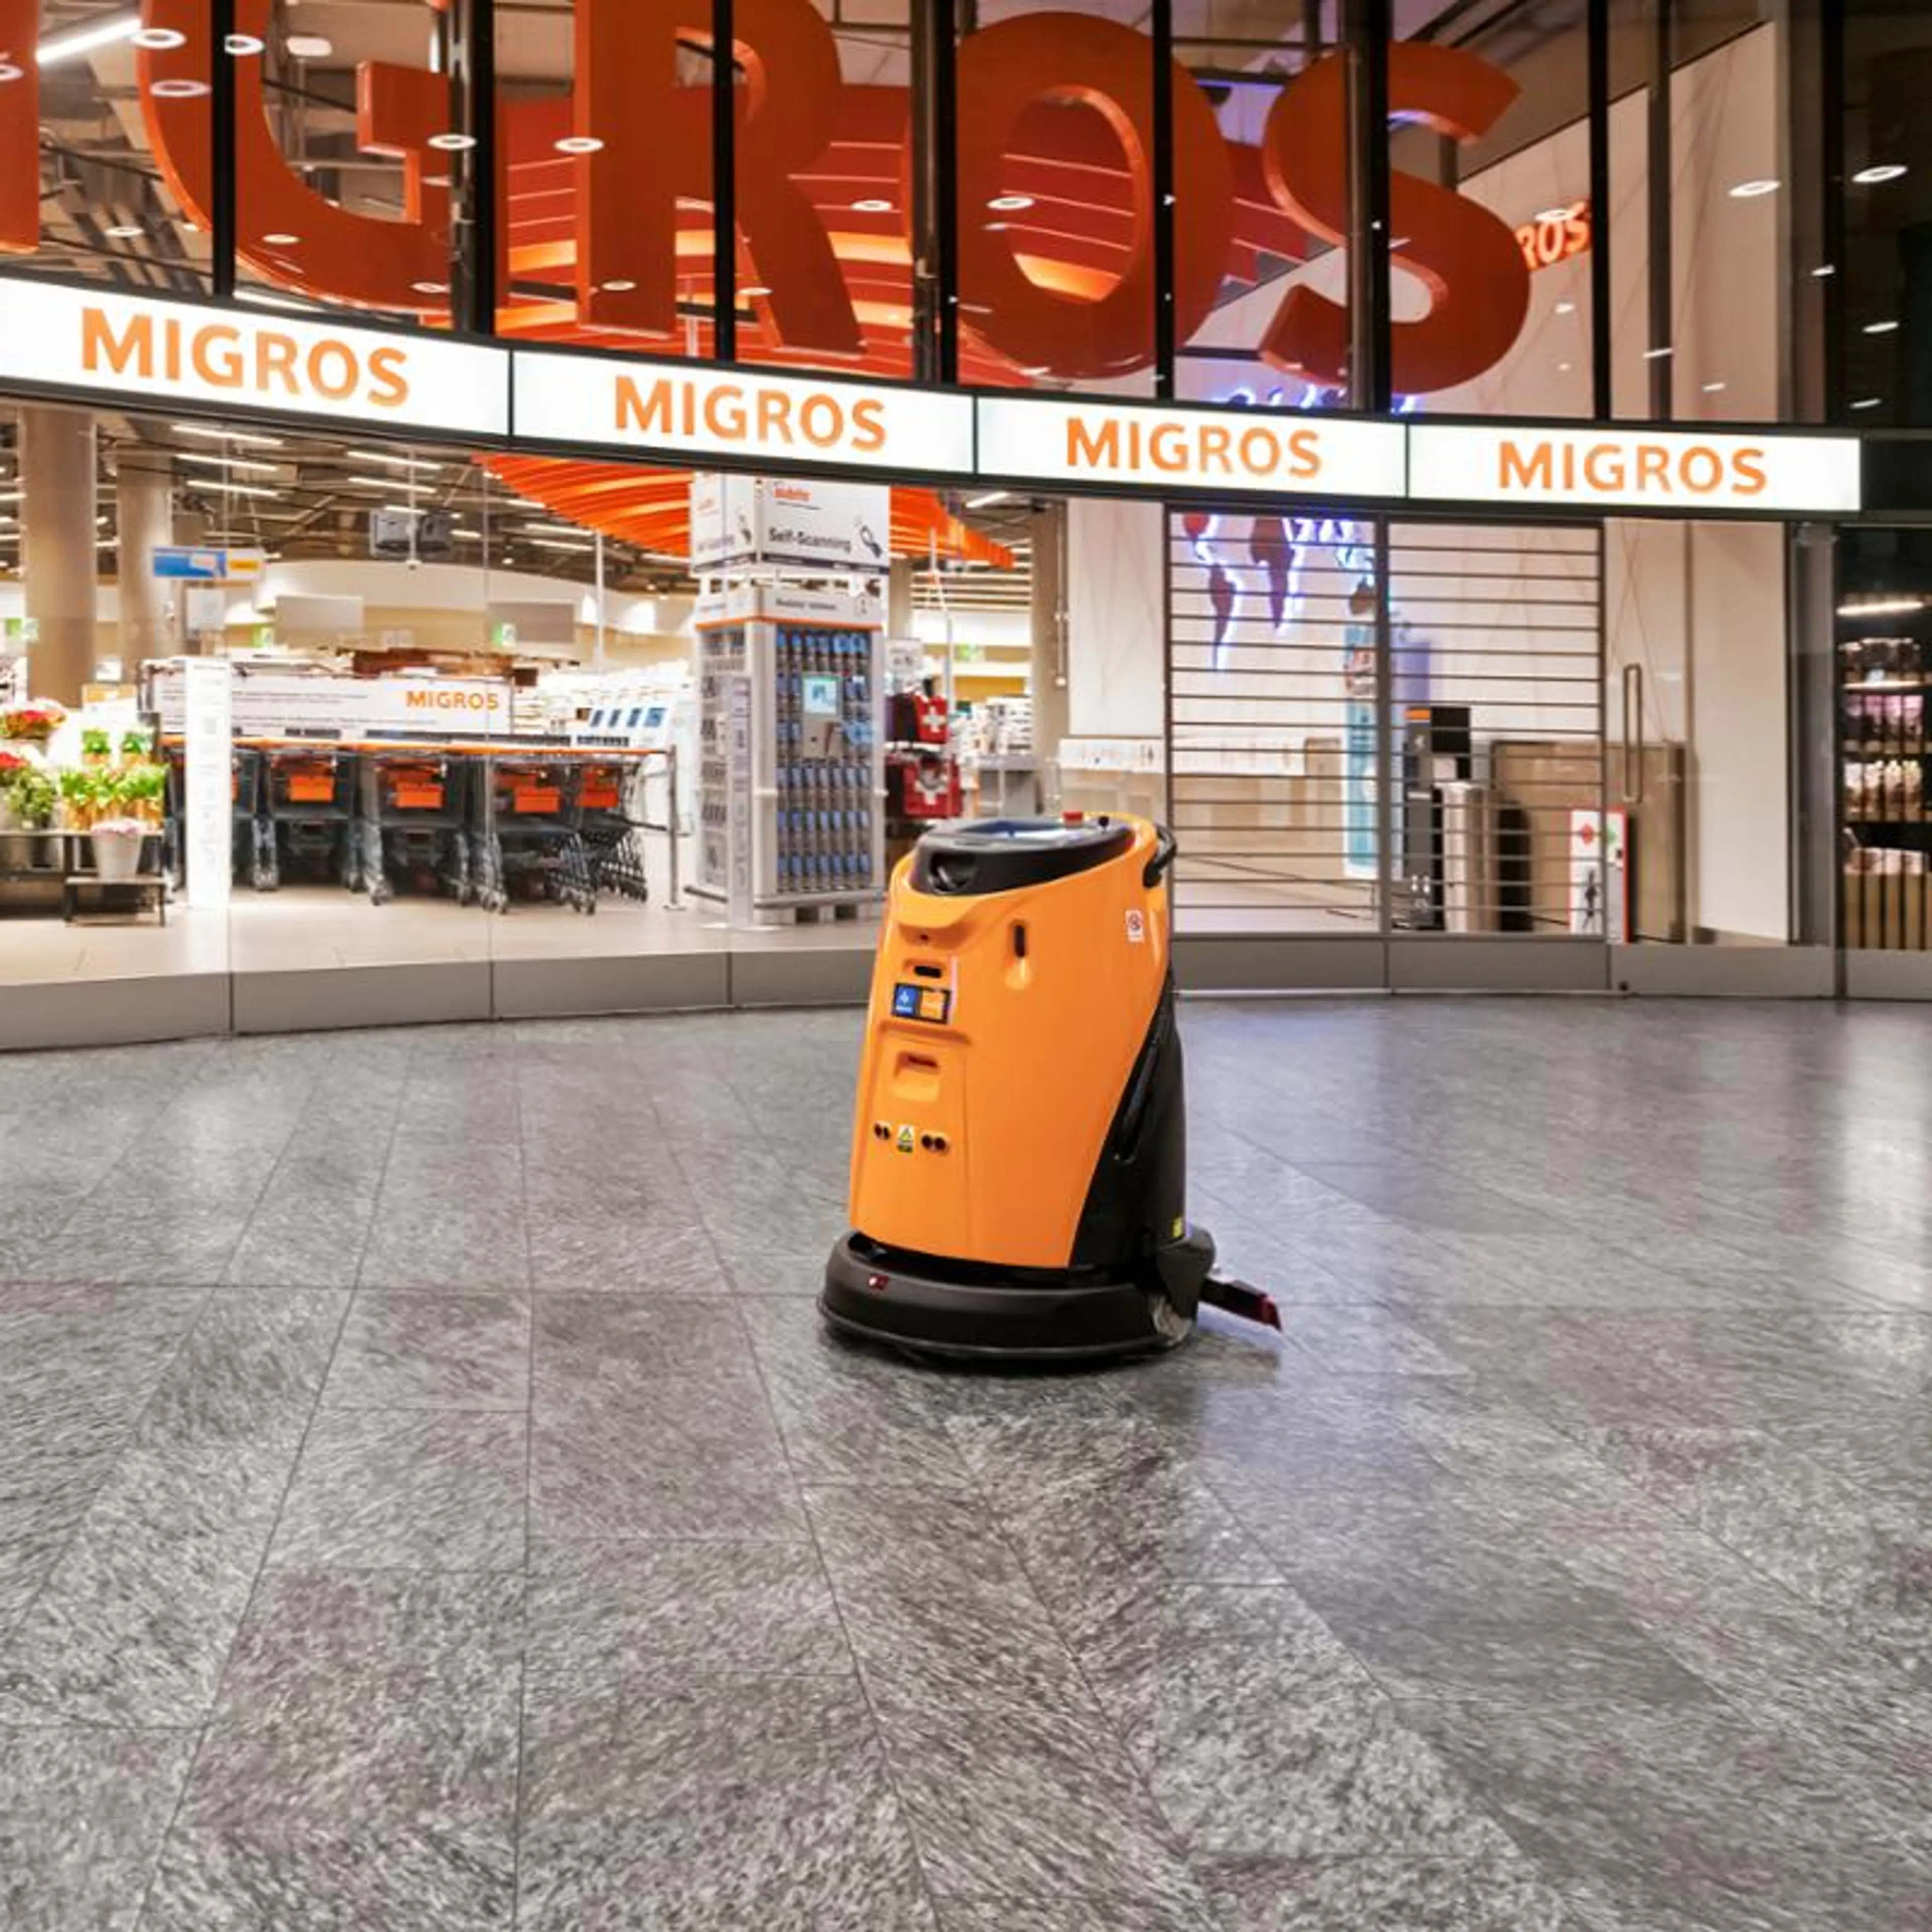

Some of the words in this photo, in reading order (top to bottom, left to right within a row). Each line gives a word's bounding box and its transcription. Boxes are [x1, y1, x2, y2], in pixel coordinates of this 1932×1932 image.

[82, 307, 410, 407] MIGROS
[615, 376, 887, 451] MIGROS
[1066, 417, 1322, 478] MIGROS
[1498, 441, 1768, 495] MIGROS
[406, 690, 499, 711] MIGROS
